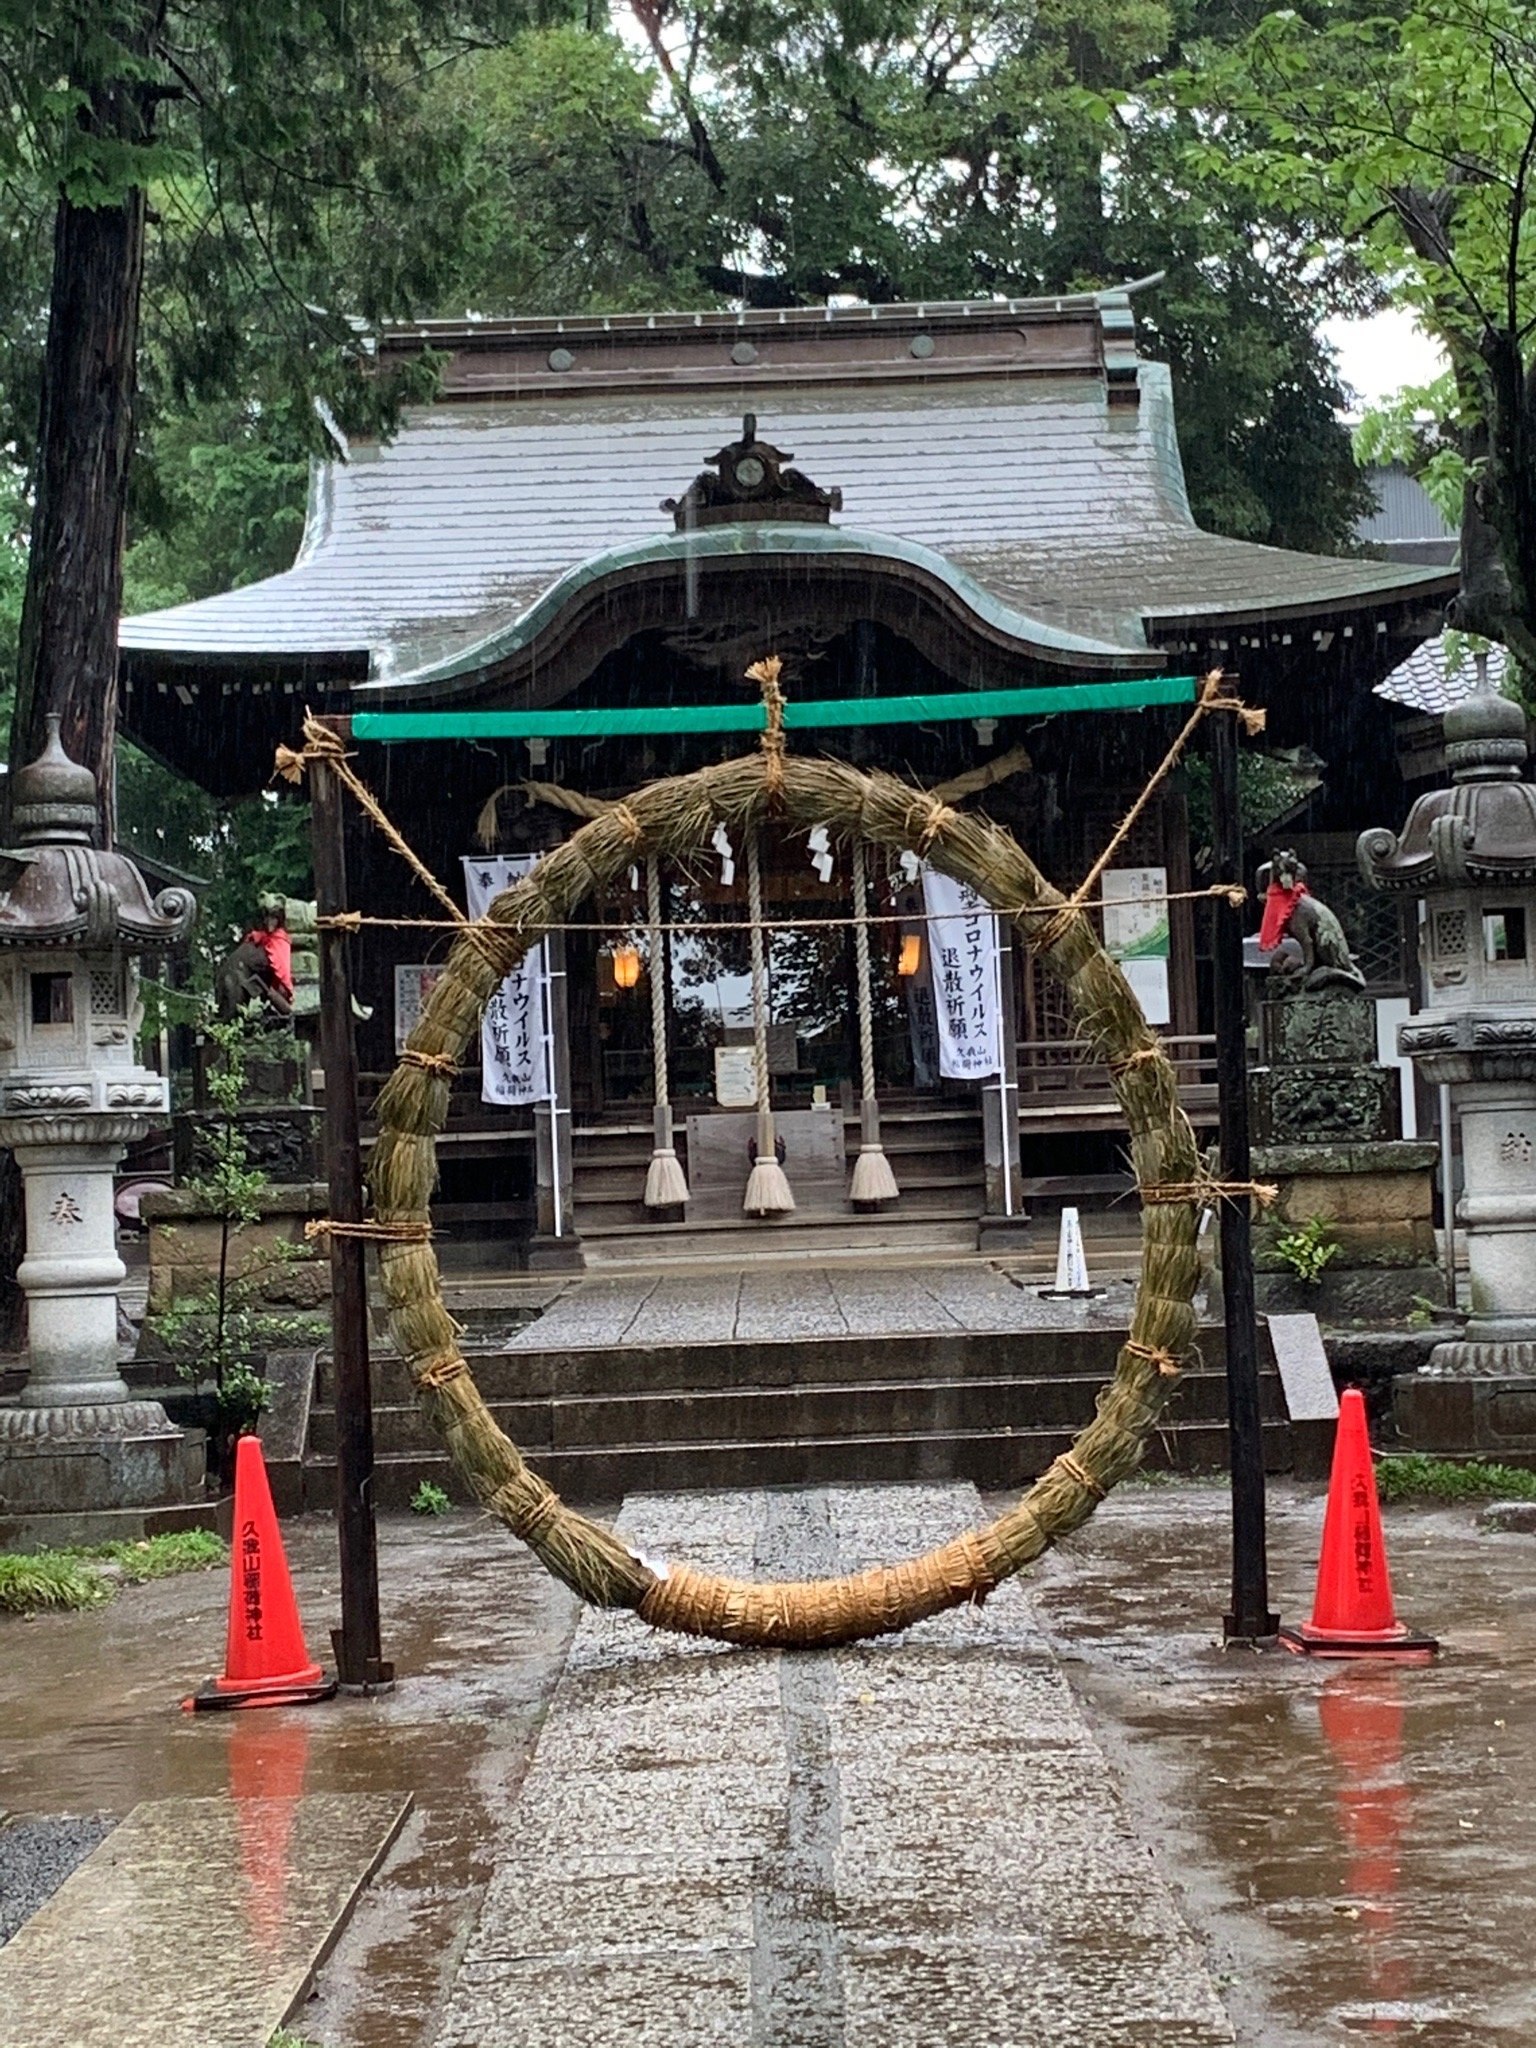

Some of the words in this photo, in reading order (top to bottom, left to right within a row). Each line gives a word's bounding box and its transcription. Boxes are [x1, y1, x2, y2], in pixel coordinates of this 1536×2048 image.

[941, 947, 968, 1040] 退散祈願
[957, 878, 987, 1038] 型コロナウイルス
[49, 1191, 83, 1225] 奉
